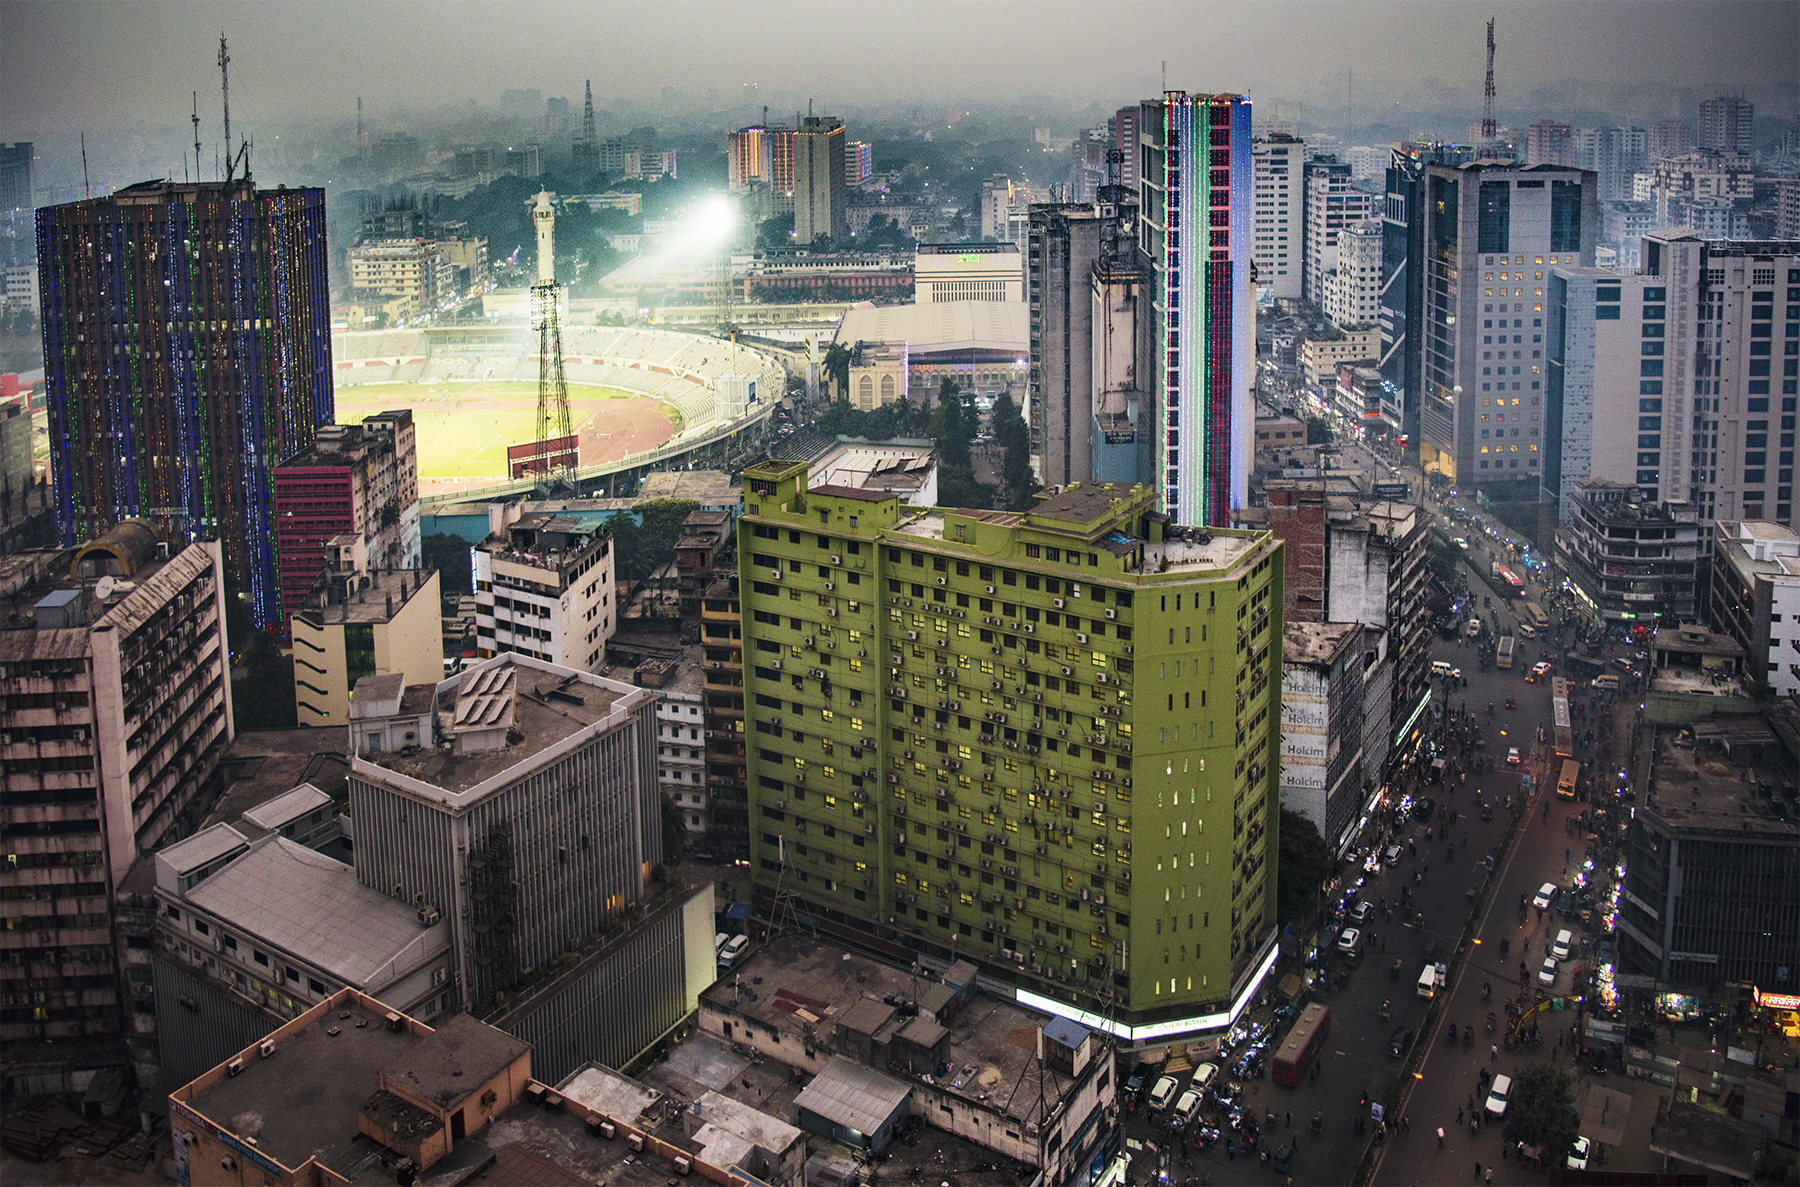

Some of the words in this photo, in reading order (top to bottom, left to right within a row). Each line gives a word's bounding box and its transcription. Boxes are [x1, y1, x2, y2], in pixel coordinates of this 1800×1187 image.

[1289, 683, 1326, 694] Holcim
[1288, 714, 1324, 725] Holcim
[1287, 745, 1324, 757] Holcim
[1287, 776, 1323, 787] Holcim
[1059, 1005, 1074, 1015] IFIC
[1074, 1010, 1097, 1022] BNK
[1168, 1021, 1184, 1029] IFIC
[1184, 1017, 1208, 1027] BANK
[177, 1103, 206, 1129] TOSHIBA
